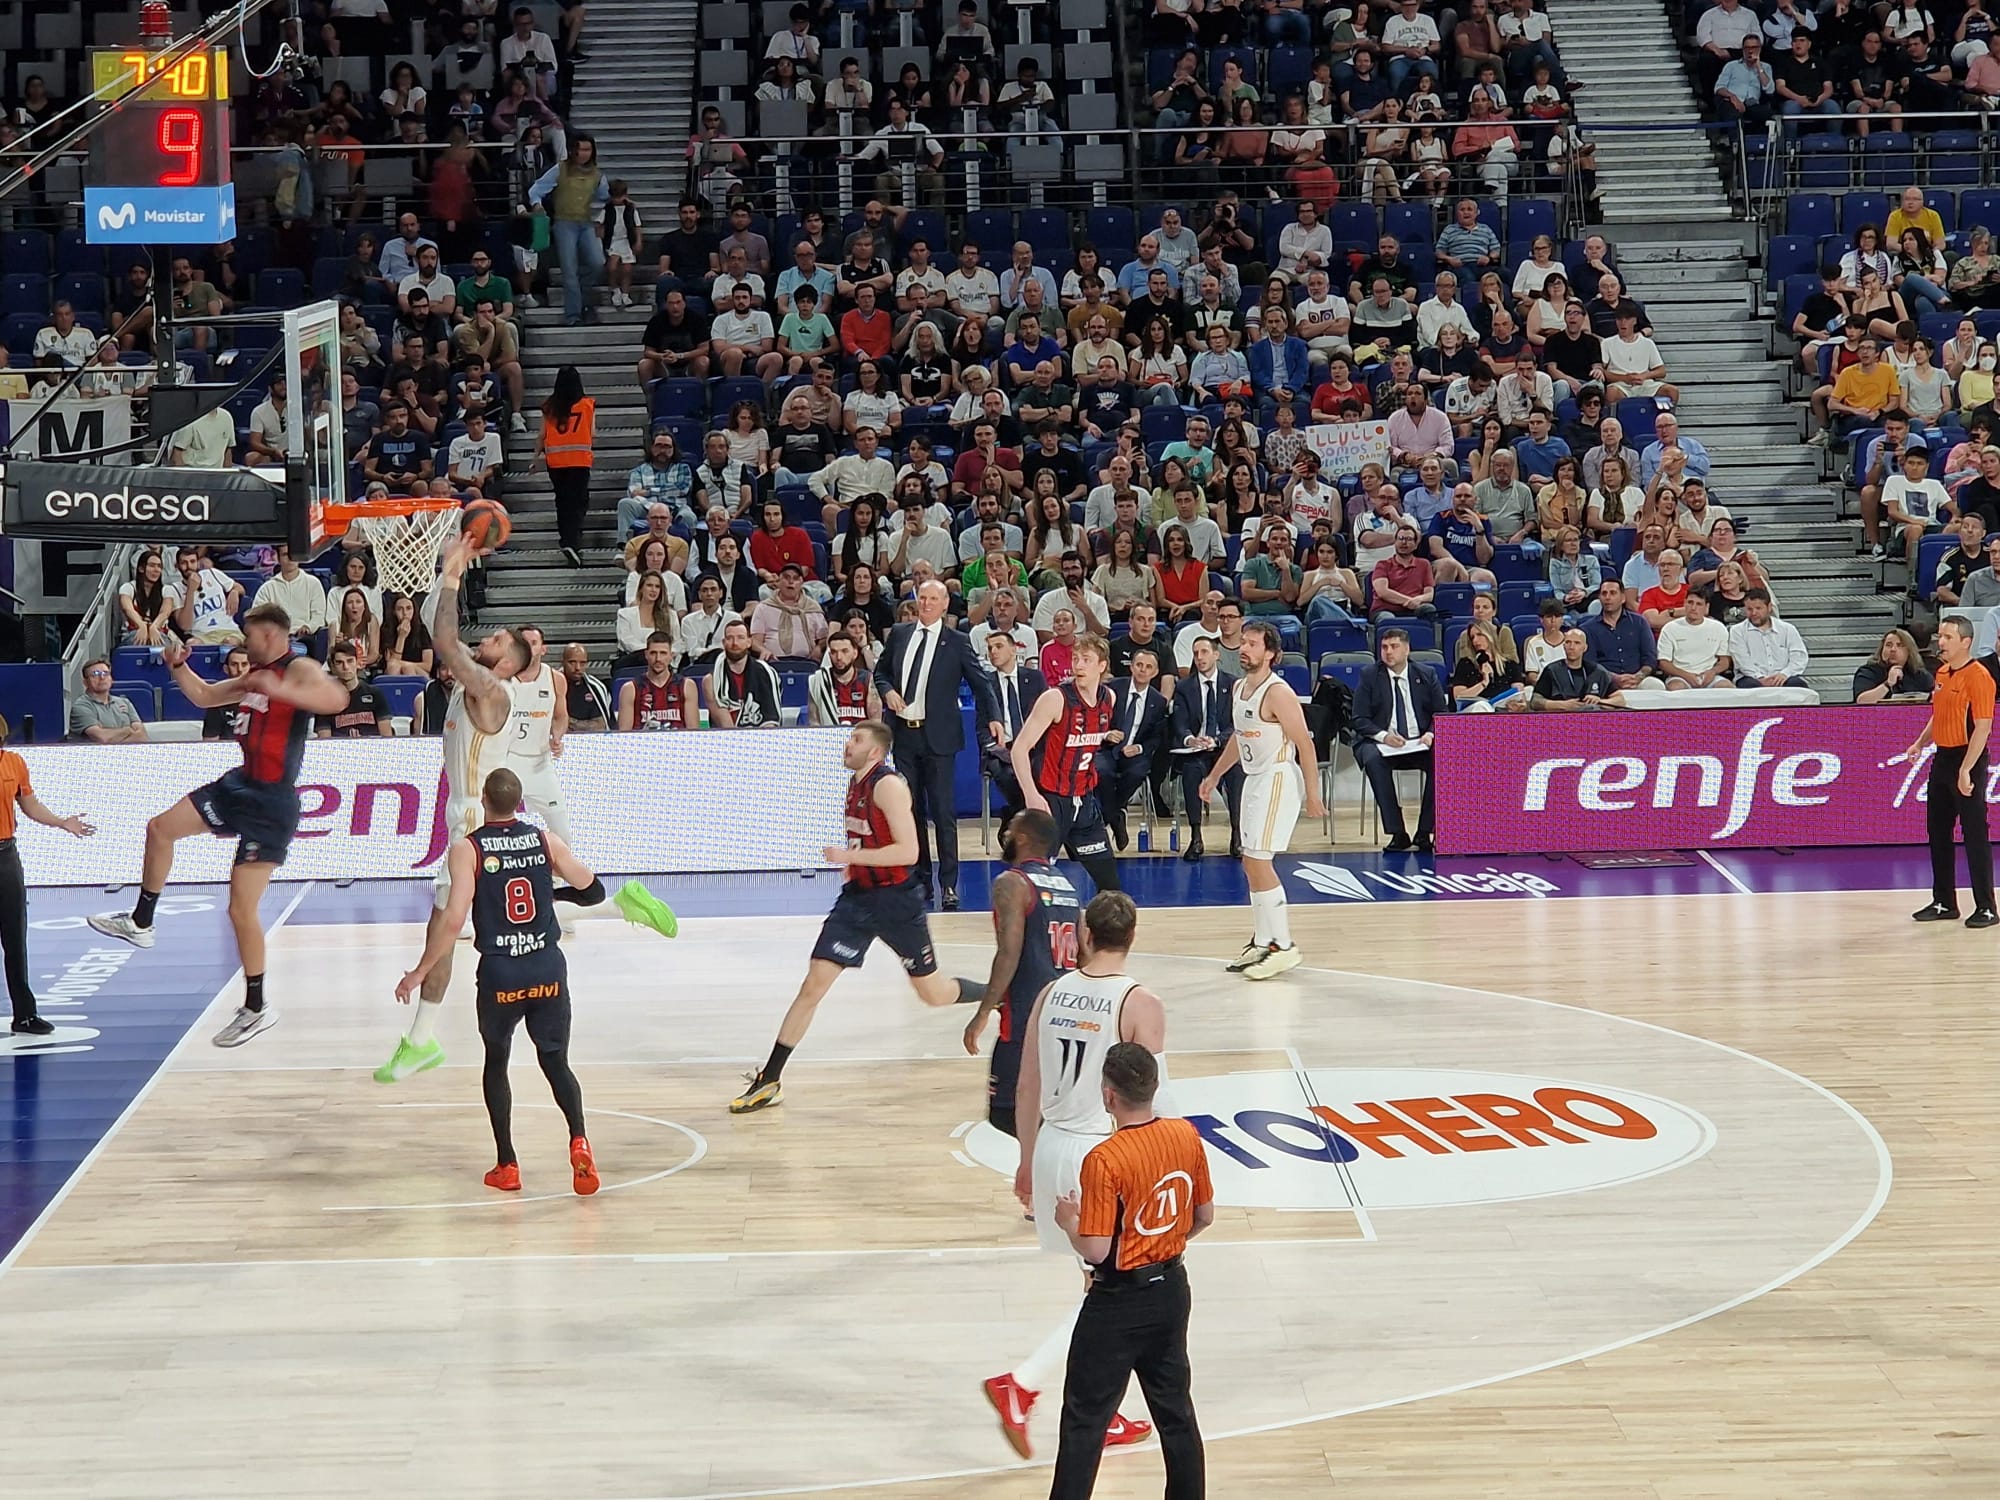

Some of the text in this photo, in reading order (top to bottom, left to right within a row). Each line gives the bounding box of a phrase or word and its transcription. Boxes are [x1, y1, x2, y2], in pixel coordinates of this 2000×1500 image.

[161, 111, 201, 185] 9
[144, 209, 205, 223] Movistar
[38, 409, 104, 464] M
[1316, 426, 1374, 448] LLULL
[45, 486, 210, 522] endesa
[193, 594, 223, 619] TAU
[518, 723, 530, 740] 5
[1078, 752, 1093, 771] 2
[1522, 716, 1842, 841] renfe
[502, 854, 546, 870] AMUTIO
[1363, 867, 1561, 898] Unicaja
[504, 876, 537, 925] 8
[496, 932, 535, 948] araba
[496, 981, 560, 1004] Recalvi
[1050, 991, 1114, 1016] HEZONJA
[1048, 1017, 1102, 1032] AUTOHERO
[1054, 1036, 1088, 1097] 11
